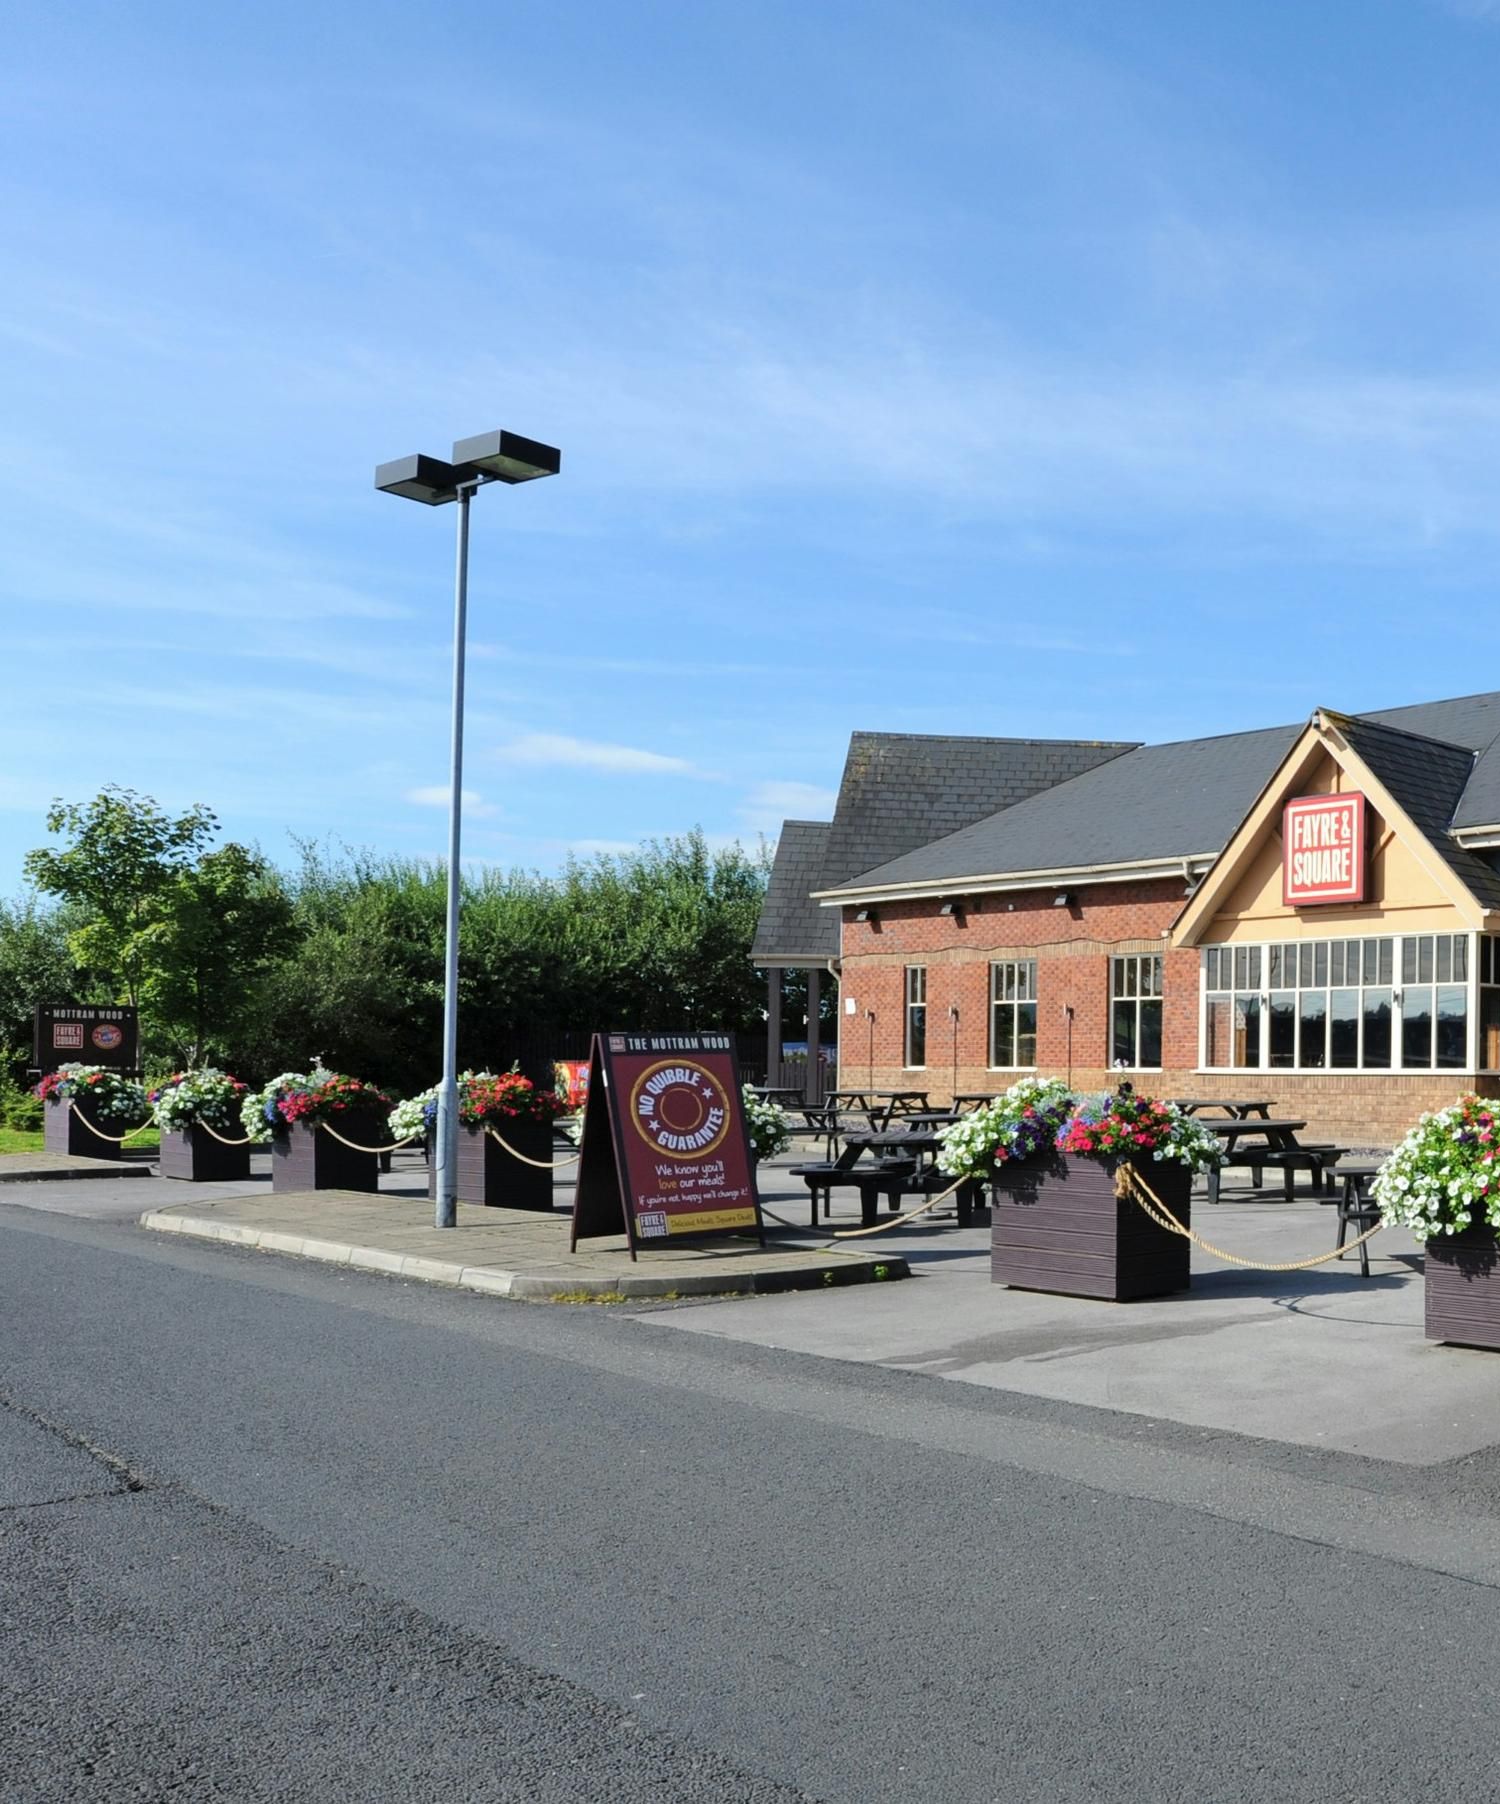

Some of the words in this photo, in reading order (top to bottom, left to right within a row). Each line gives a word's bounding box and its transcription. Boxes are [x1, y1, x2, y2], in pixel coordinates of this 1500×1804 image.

[1294, 811, 1339, 849] FAYRE
[1341, 810, 1351, 843] &
[1293, 847, 1351, 887] SQUARE
[53, 1009, 95, 1019] MOTTRAM
[98, 1010, 123, 1020] WOOD
[628, 1038, 647, 1050] THE
[651, 1037, 699, 1050] MOTTRAM
[701, 1037, 730, 1049] WOOD
[646, 1068, 701, 1095] QUIBBLE
[639, 1095, 655, 1115] NO
[657, 1107, 723, 1150] GUARANTEE
[655, 1165, 673, 1176] We
[675, 1164, 699, 1174] know
[701, 1160, 724, 1179] you'll
[658, 1179, 677, 1190] love
[680, 1179, 694, 1188] our
[638, 1195, 645, 1206] If
[647, 1195, 666, 1208] you're
[682, 1193, 702, 1204] happy
[703, 1190, 716, 1199] we'll
[718, 1190, 739, 1201] change
[641, 1215, 659, 1227] FAYRE
[642, 1226, 667, 1238] SQUARE
